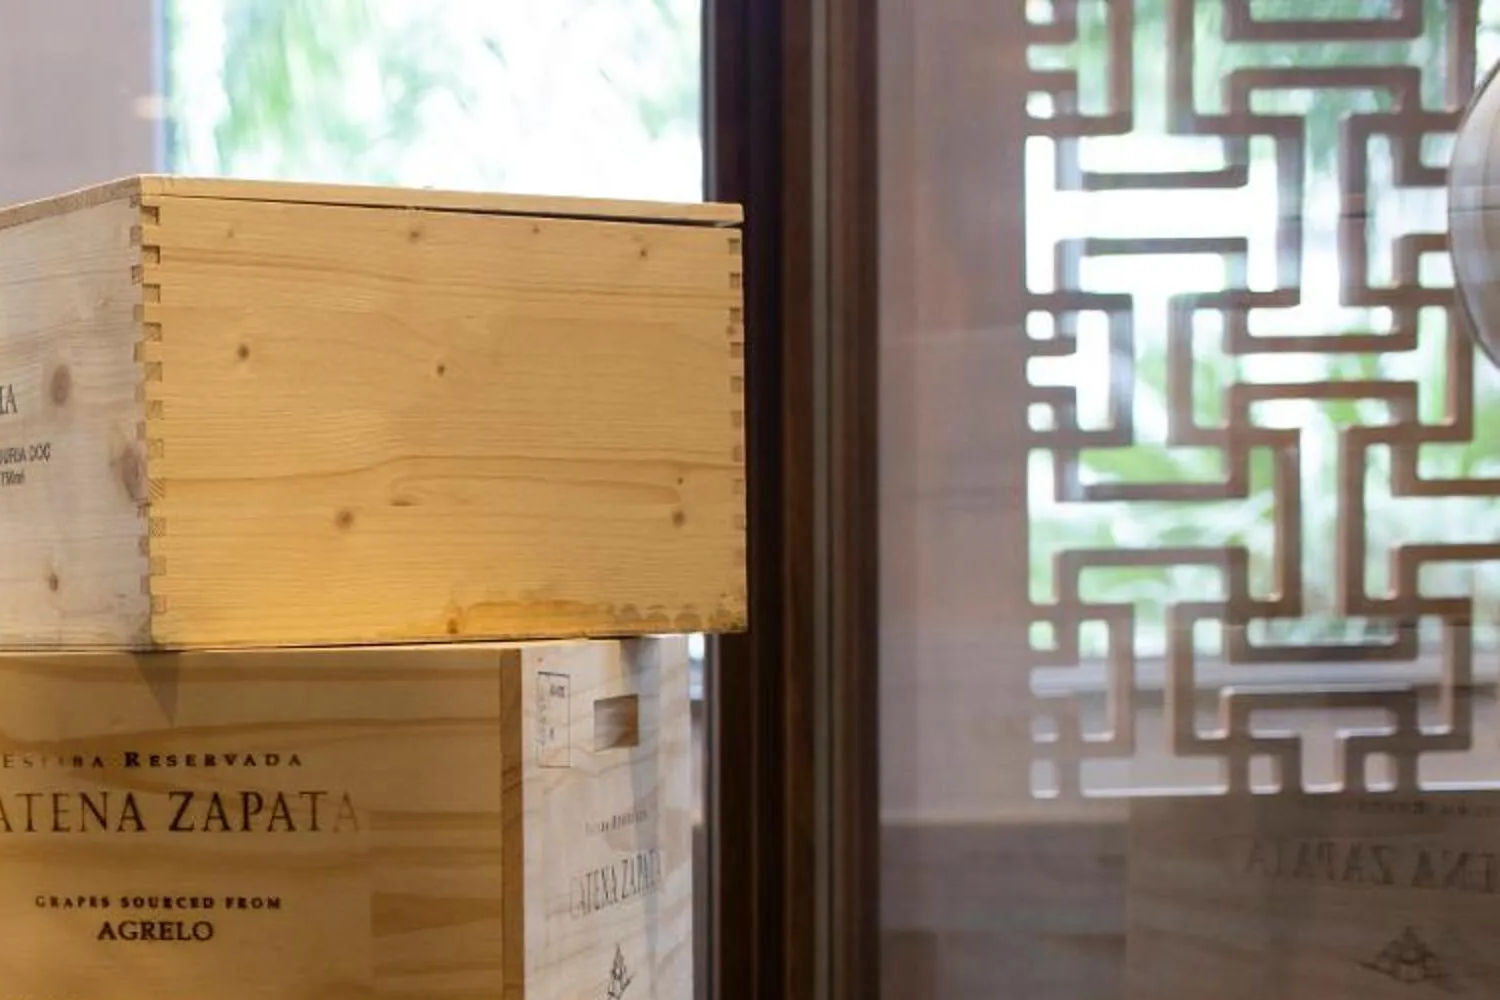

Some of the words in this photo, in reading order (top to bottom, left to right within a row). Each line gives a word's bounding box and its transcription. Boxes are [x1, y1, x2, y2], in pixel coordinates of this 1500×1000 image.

[124, 751, 302, 768] RESERVADA
[168, 790, 360, 834] ZAPATA
[34, 895, 110, 909] GRAPES
[120, 896, 215, 910] SOURCED
[225, 896, 282, 910] FROM
[96, 920, 215, 941] AGRELO
